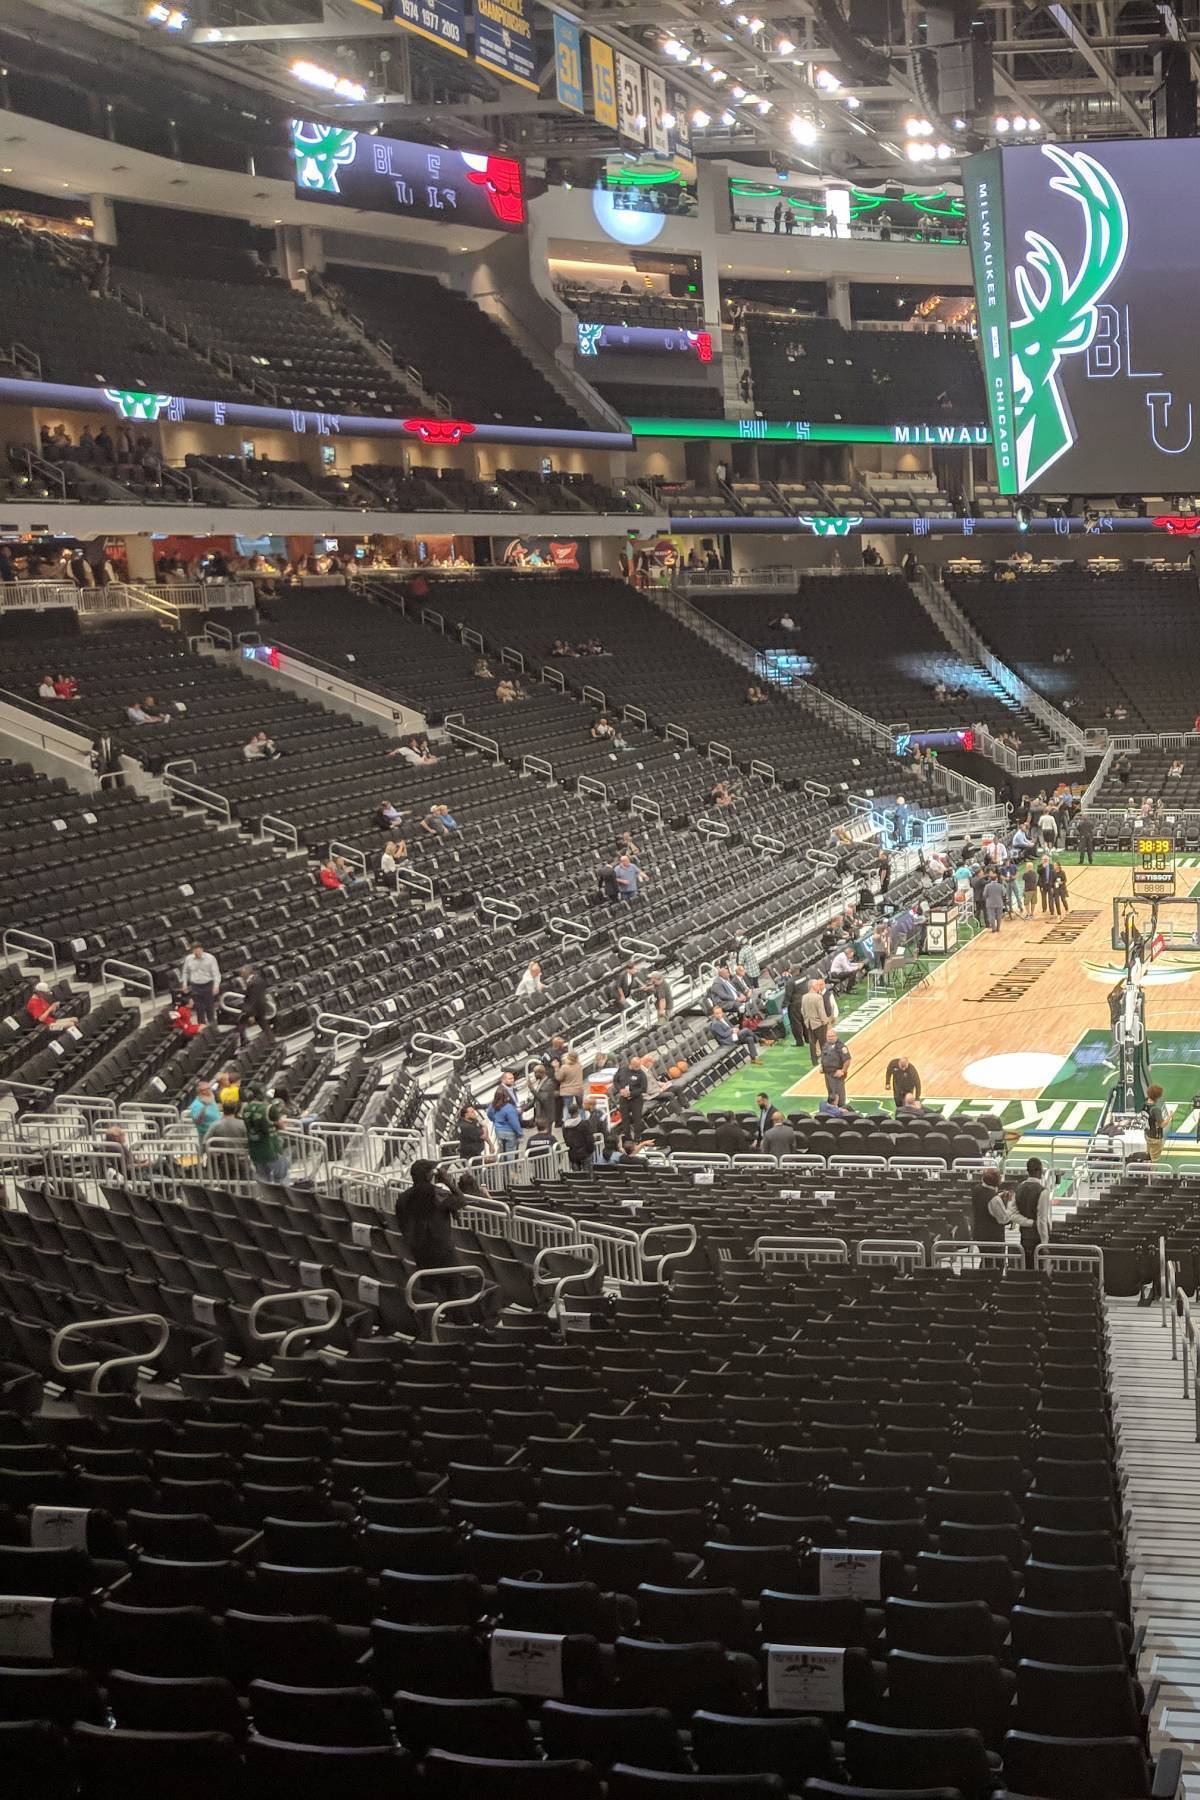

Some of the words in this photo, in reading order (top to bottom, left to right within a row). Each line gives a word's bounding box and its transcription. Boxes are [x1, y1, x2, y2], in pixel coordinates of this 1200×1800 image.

[978, 183, 996, 307] MILWAUKEE
[995, 377, 1010, 468] CHICAGO
[1138, 840, 1170, 852] 38:39
[1126, 1064, 1135, 1097] NBA
